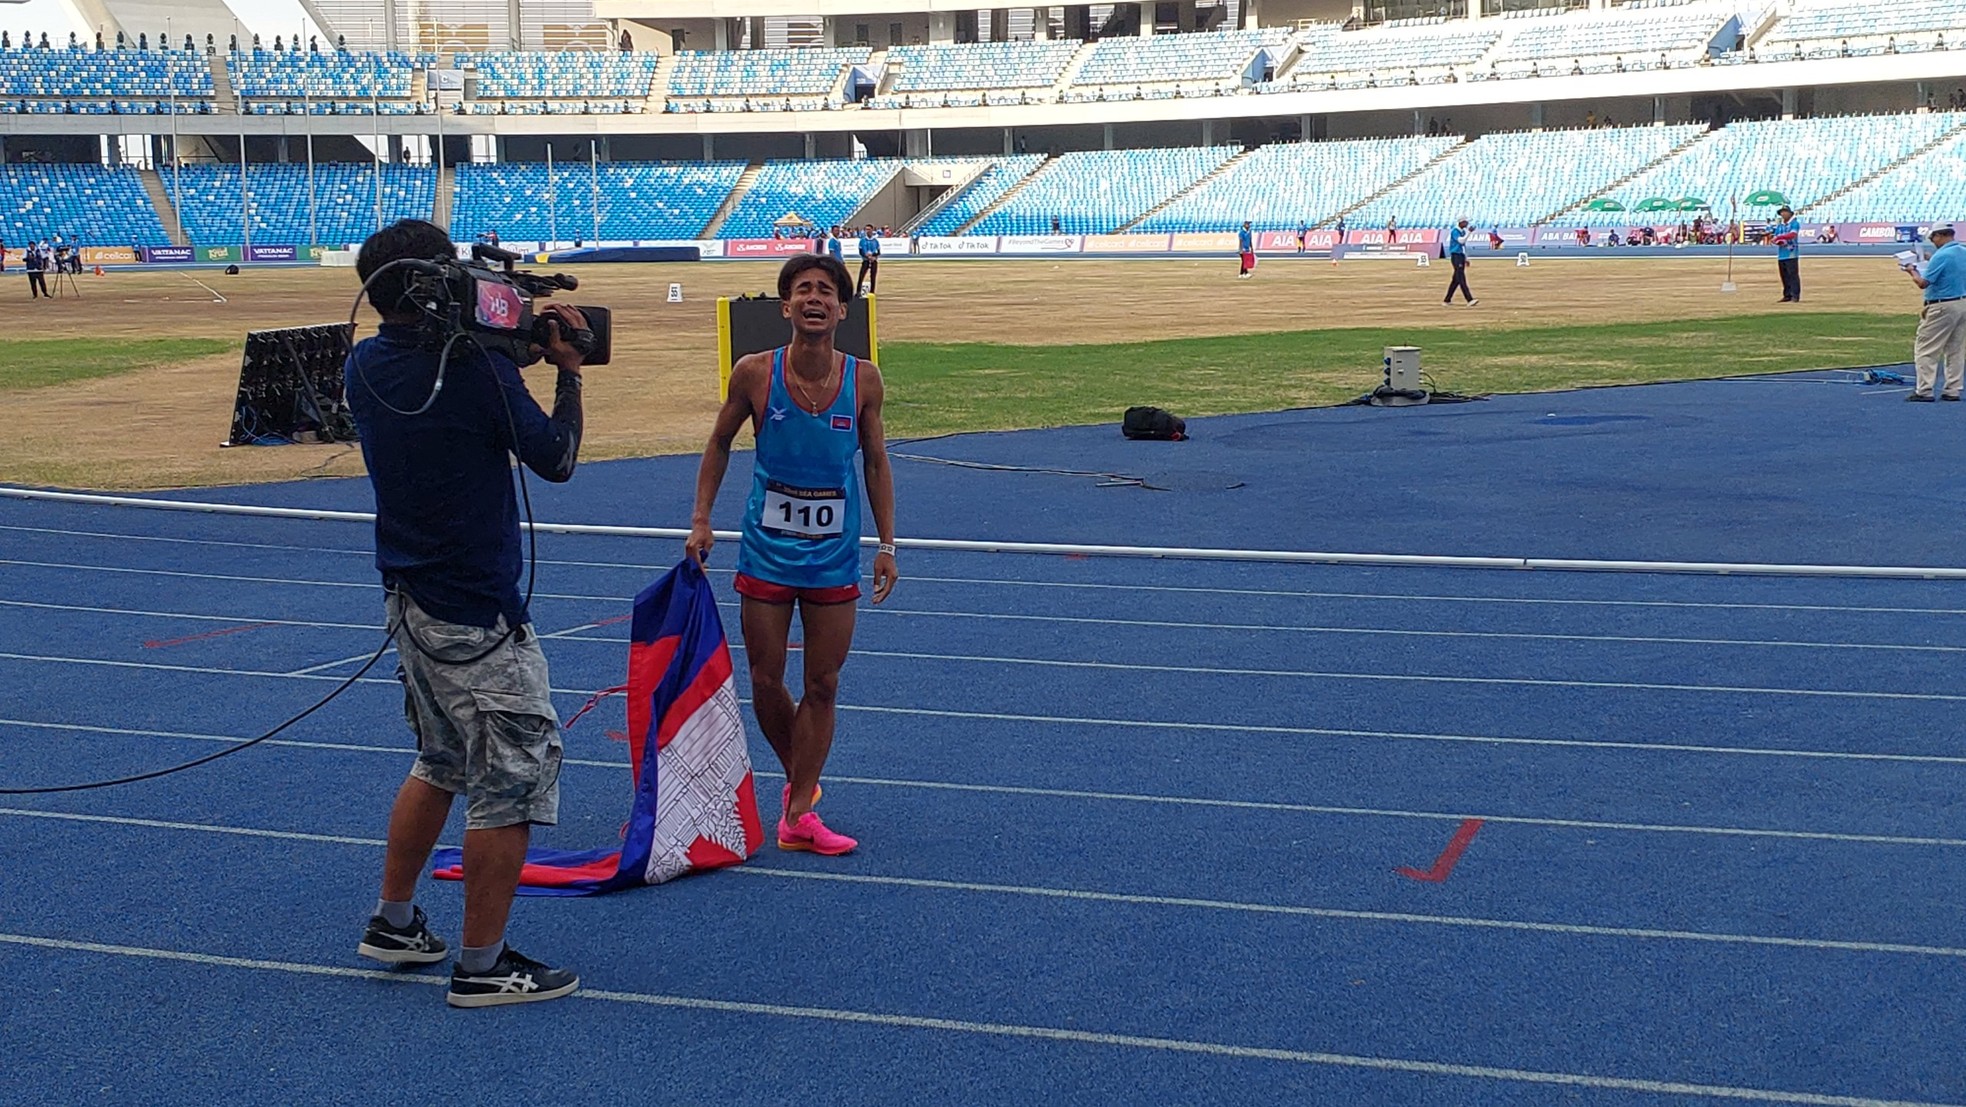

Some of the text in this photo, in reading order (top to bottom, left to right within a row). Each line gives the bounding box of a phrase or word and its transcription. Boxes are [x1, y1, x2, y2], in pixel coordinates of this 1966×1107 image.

[1859, 226, 1896, 237] CAMBOD
[1272, 235, 1295, 247] AIA
[1308, 235, 1333, 247] AIA
[1360, 233, 1384, 244] AIA
[1400, 232, 1423, 243] AIA
[103, 251, 132, 260] cellcar
[778, 501, 834, 528] 110
